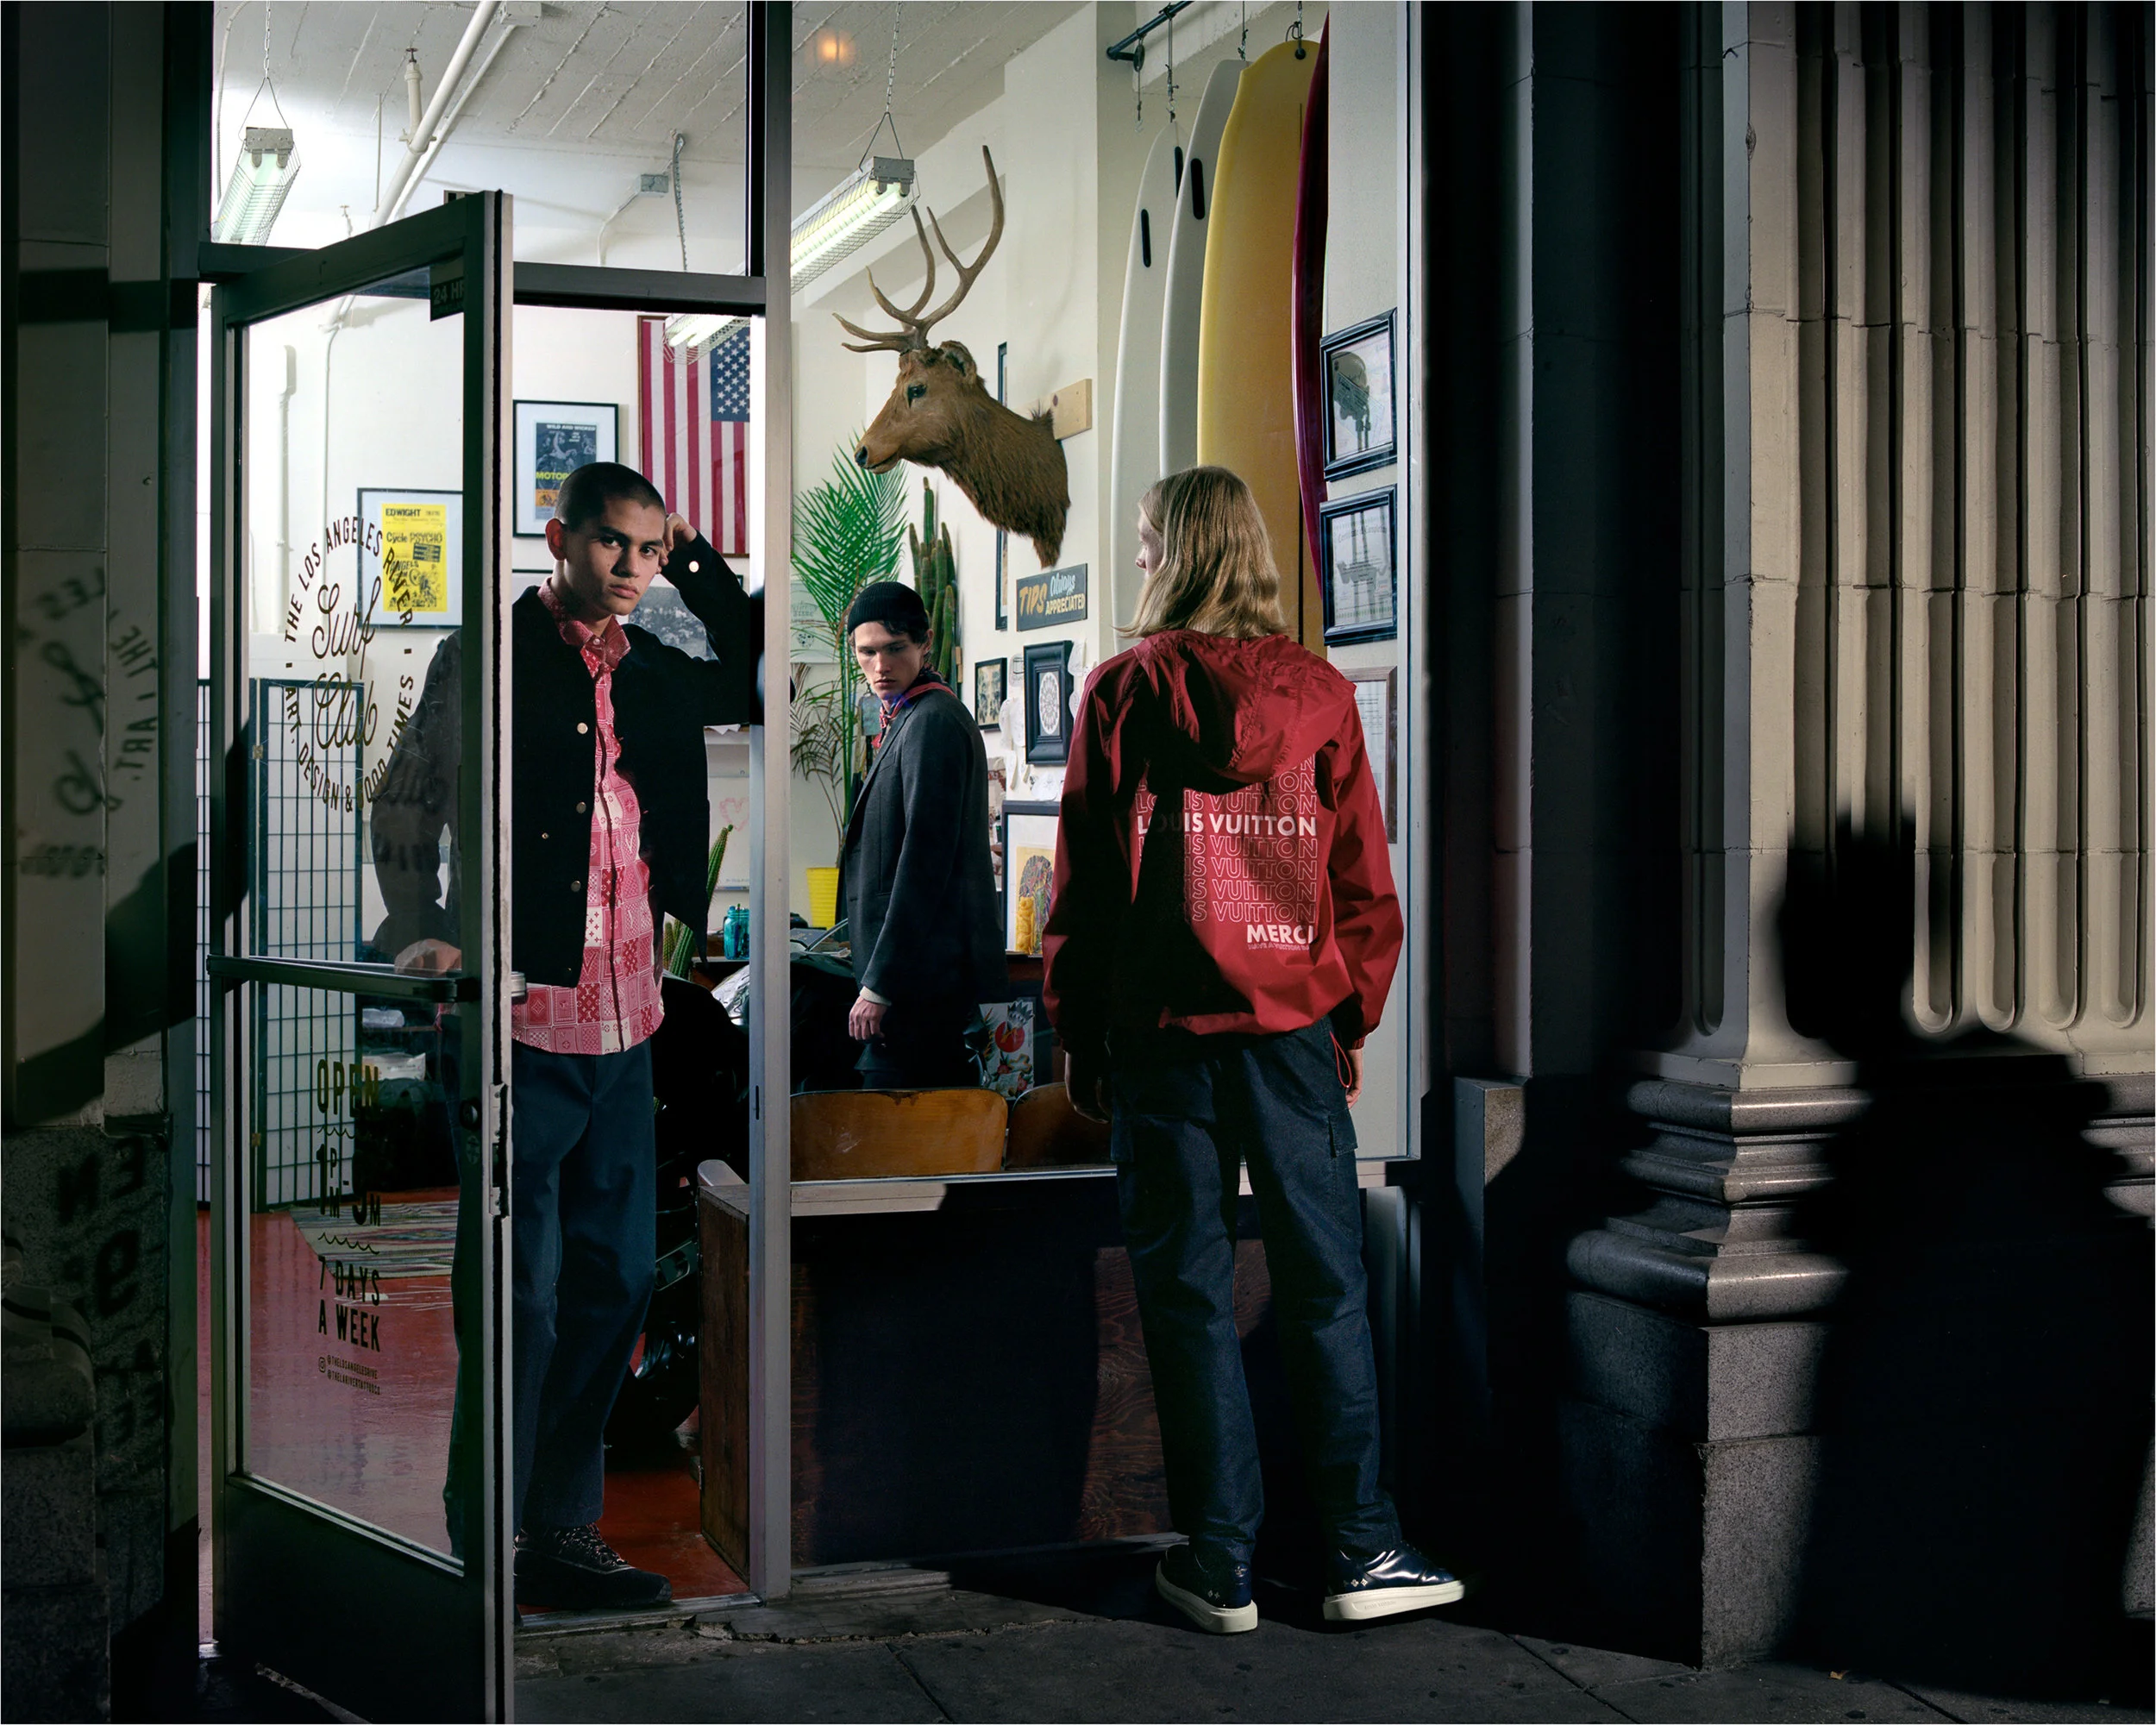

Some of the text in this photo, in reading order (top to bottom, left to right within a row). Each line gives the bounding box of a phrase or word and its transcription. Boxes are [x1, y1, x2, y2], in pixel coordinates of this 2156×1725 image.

[536, 471, 572, 480] MOTOR
[385, 530, 408, 543] Cycle
[285, 517, 412, 643] THE LOS ANGELES RIVER
[1019, 583, 1048, 616] TIPS
[1045, 593, 1086, 615] APPRECIATED
[312, 575, 381, 680] Surf
[315, 672, 378, 750] Club
[298, 742, 340, 810] DESIGN
[386, 674, 414, 759] TIMES
[1208, 813, 1317, 837] VUITTON
[1209, 835, 1319, 858] VUITTON
[1211, 856, 1318, 881] VUITTON
[1212, 879, 1317, 902] VUITTON
[1213, 901, 1316, 924] VUITTON
[1247, 924, 1313, 944] MERCI
[317, 1058, 379, 1119] OPEN
[317, 1254, 380, 1307] 7 DAYS
[318, 1299, 380, 1352] A WEEK
